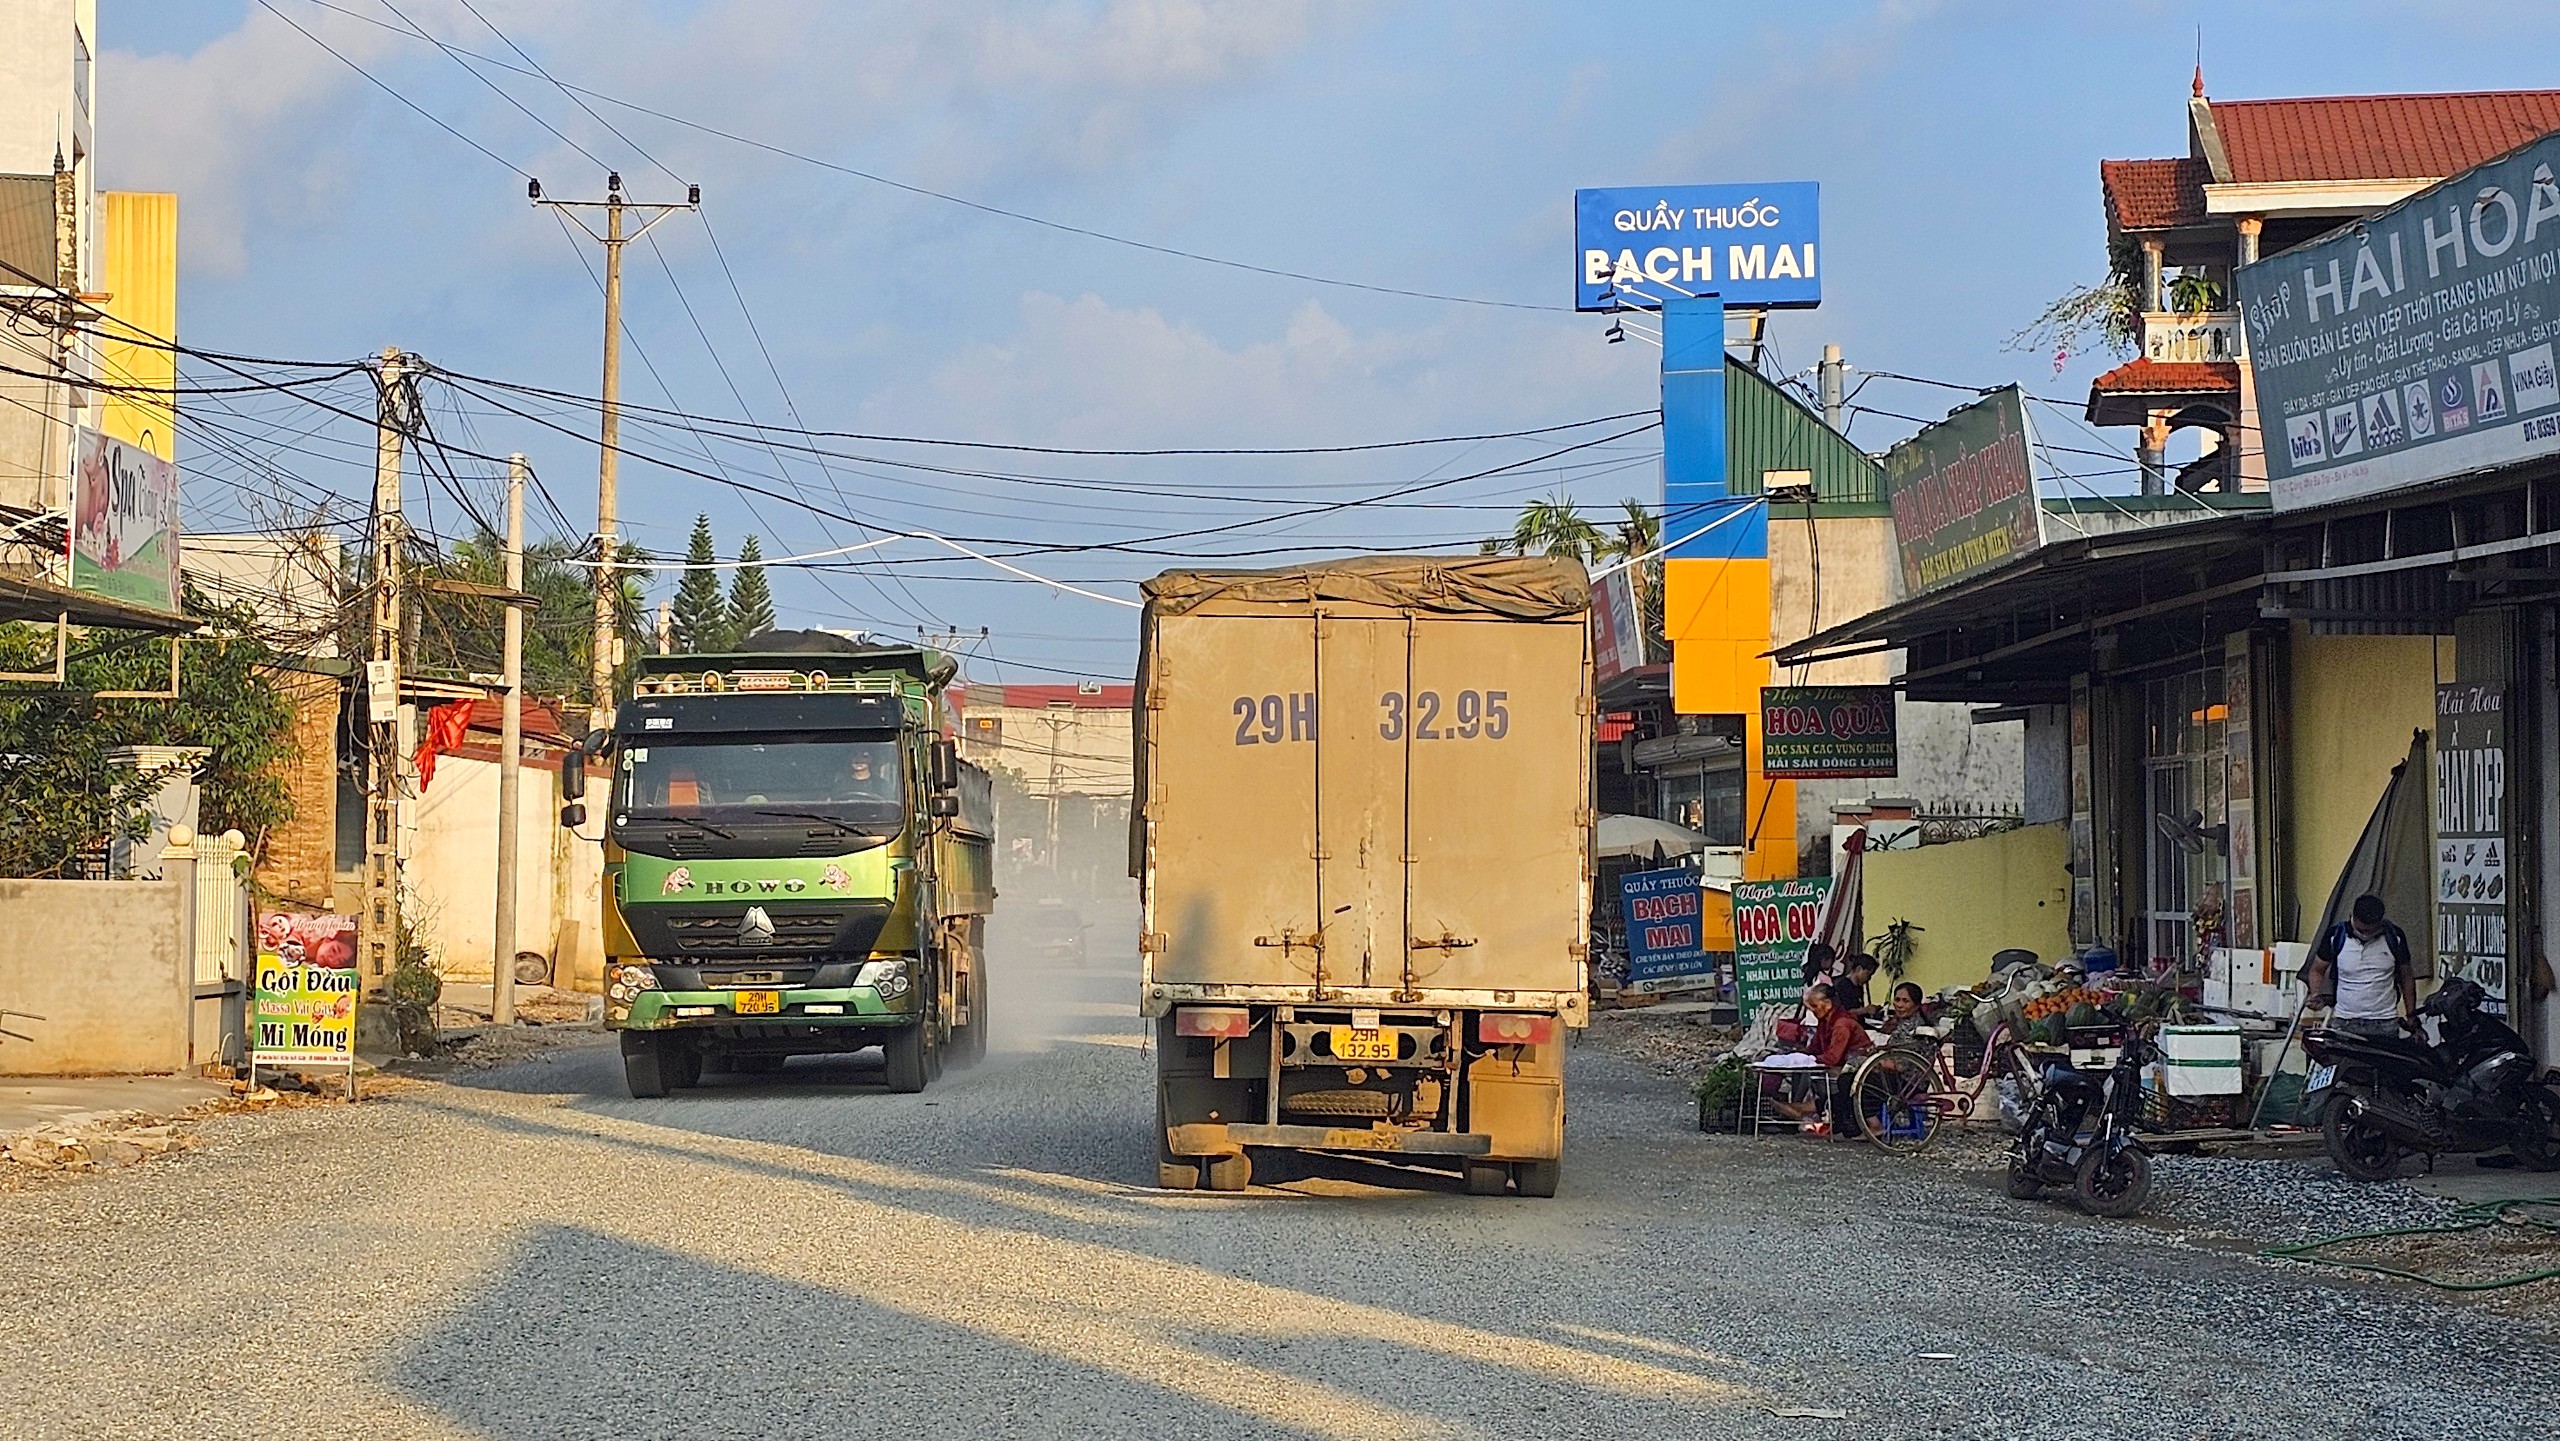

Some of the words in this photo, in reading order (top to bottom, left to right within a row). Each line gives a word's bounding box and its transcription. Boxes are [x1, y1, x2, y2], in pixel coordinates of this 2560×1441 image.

[1614, 199, 1685, 231] QUẦY
[1693, 197, 1780, 230] THUỐC
[1729, 243, 1815, 281] MAI
[2304, 222, 2405, 323] HẢI
[2280, 335, 2309, 366] BUÔN
[2311, 328, 2334, 358] BÁN
[2380, 304, 2401, 335] DÉP
[2433, 280, 2475, 315] TRANG
[2476, 269, 2506, 301] NAM
[2529, 250, 2556, 285] MỌI
[2338, 355, 2352, 380] Uy
[2354, 350, 2368, 372] tín
[2400, 330, 2434, 356] Lượng
[2442, 314, 2461, 342] Giá
[2480, 306, 2503, 333] Hợp
[2506, 295, 2520, 326] Lý
[2360, 378, 2375, 394] CAO
[2427, 355, 2447, 374] THAO
[2451, 344, 2484, 366] SANDAL
[2513, 372, 2534, 393] VINA
[2334, 411, 2351, 436] NIKE
[2368, 427, 2405, 450] adidas
[111, 445, 136, 541] Spa
[1892, 485, 1922, 546] HOA
[2469, 686, 2501, 713] Hoa
[1233, 693, 1316, 746] 29H
[1766, 706, 1826, 736] HOA
[1829, 694, 1890, 740] QUẢ
[2473, 729, 2505, 833] DÉP
[705, 879, 806, 895] HOWO
[1777, 881, 1814, 898] Mai
[1632, 892, 1698, 924] BẠCH
[1737, 903, 1783, 946] HOA
[1645, 924, 1693, 950] MAI
[262, 970, 299, 995] Gội
[306, 968, 351, 992] Đầu
[260, 999, 290, 1014] Massa
[260, 1023, 284, 1046] Mi
[292, 1023, 348, 1052] Móng
[1340, 1043, 1391, 1058] 132.95
